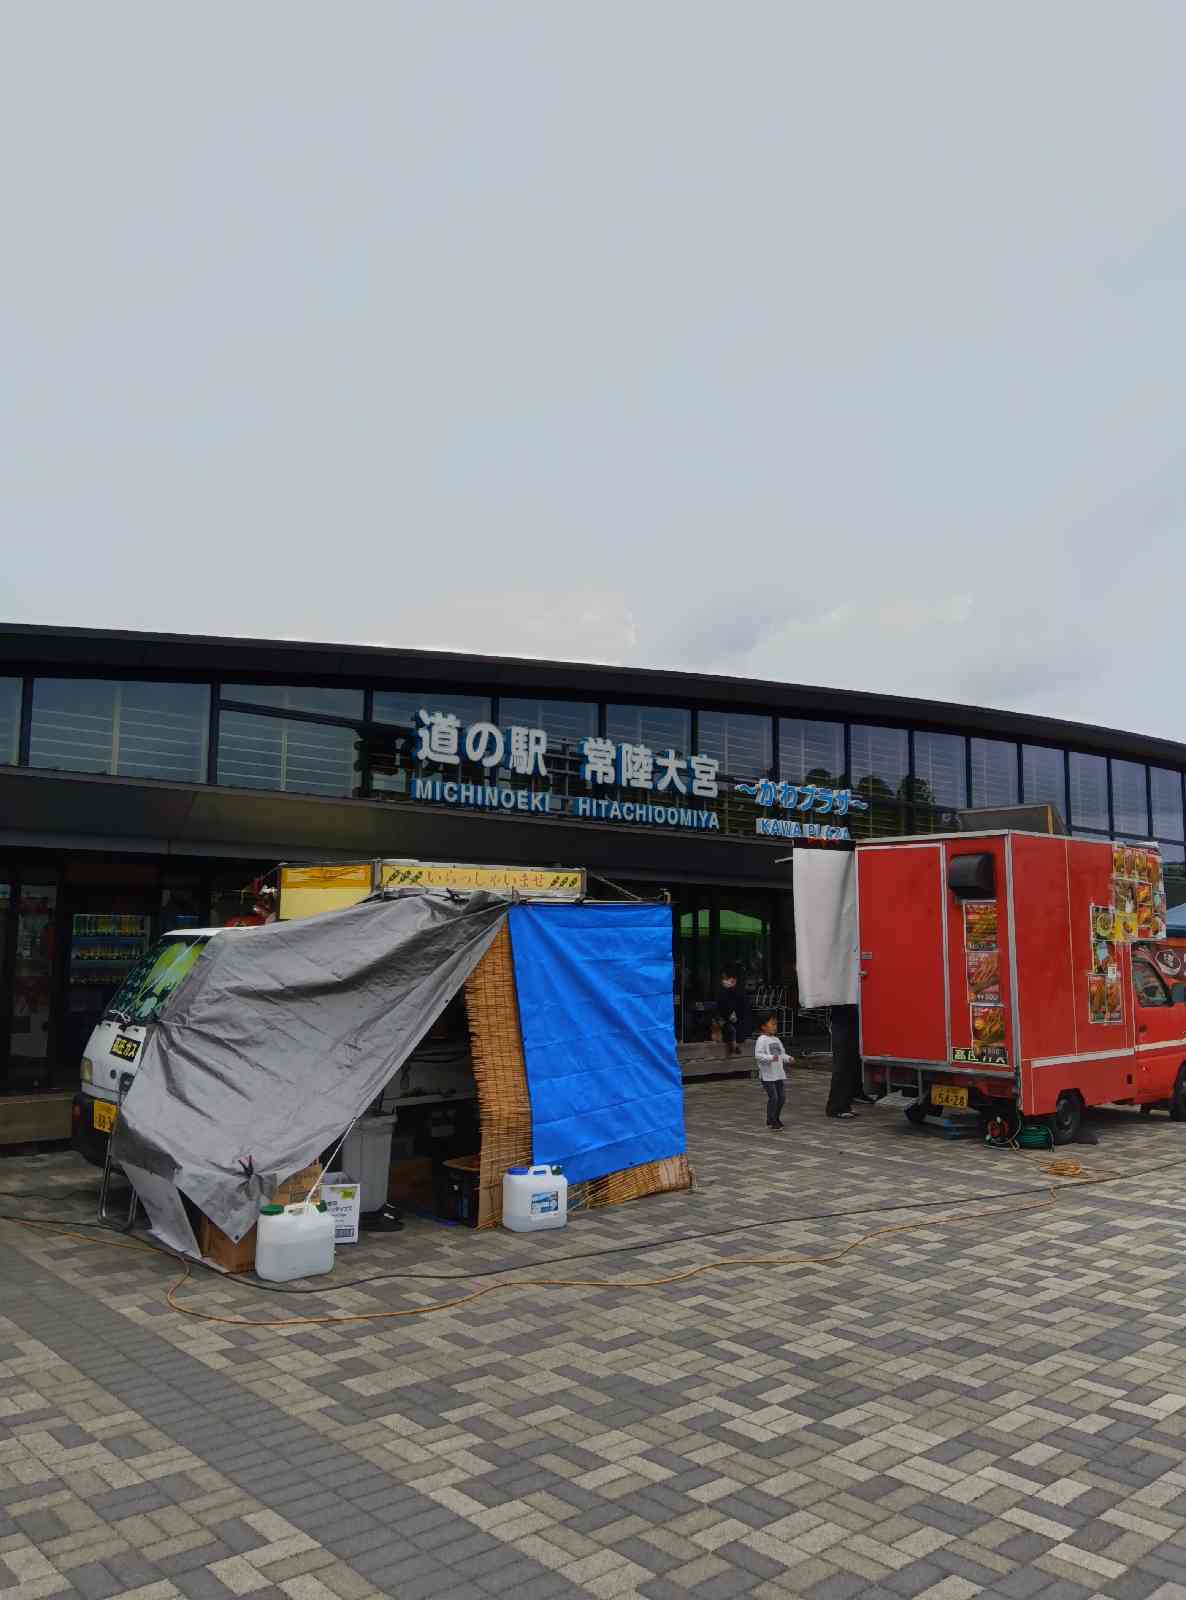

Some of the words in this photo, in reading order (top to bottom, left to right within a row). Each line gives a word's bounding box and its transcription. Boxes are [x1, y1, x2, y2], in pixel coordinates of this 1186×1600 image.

[416, 709, 548, 777] 道の駅
[583, 737, 720, 799] 常陸大宮
[415, 779, 550, 812] MICHINOEKI
[577, 797, 721, 830] HITACHIOOMIYA
[757, 817, 801, 838] KAWA
